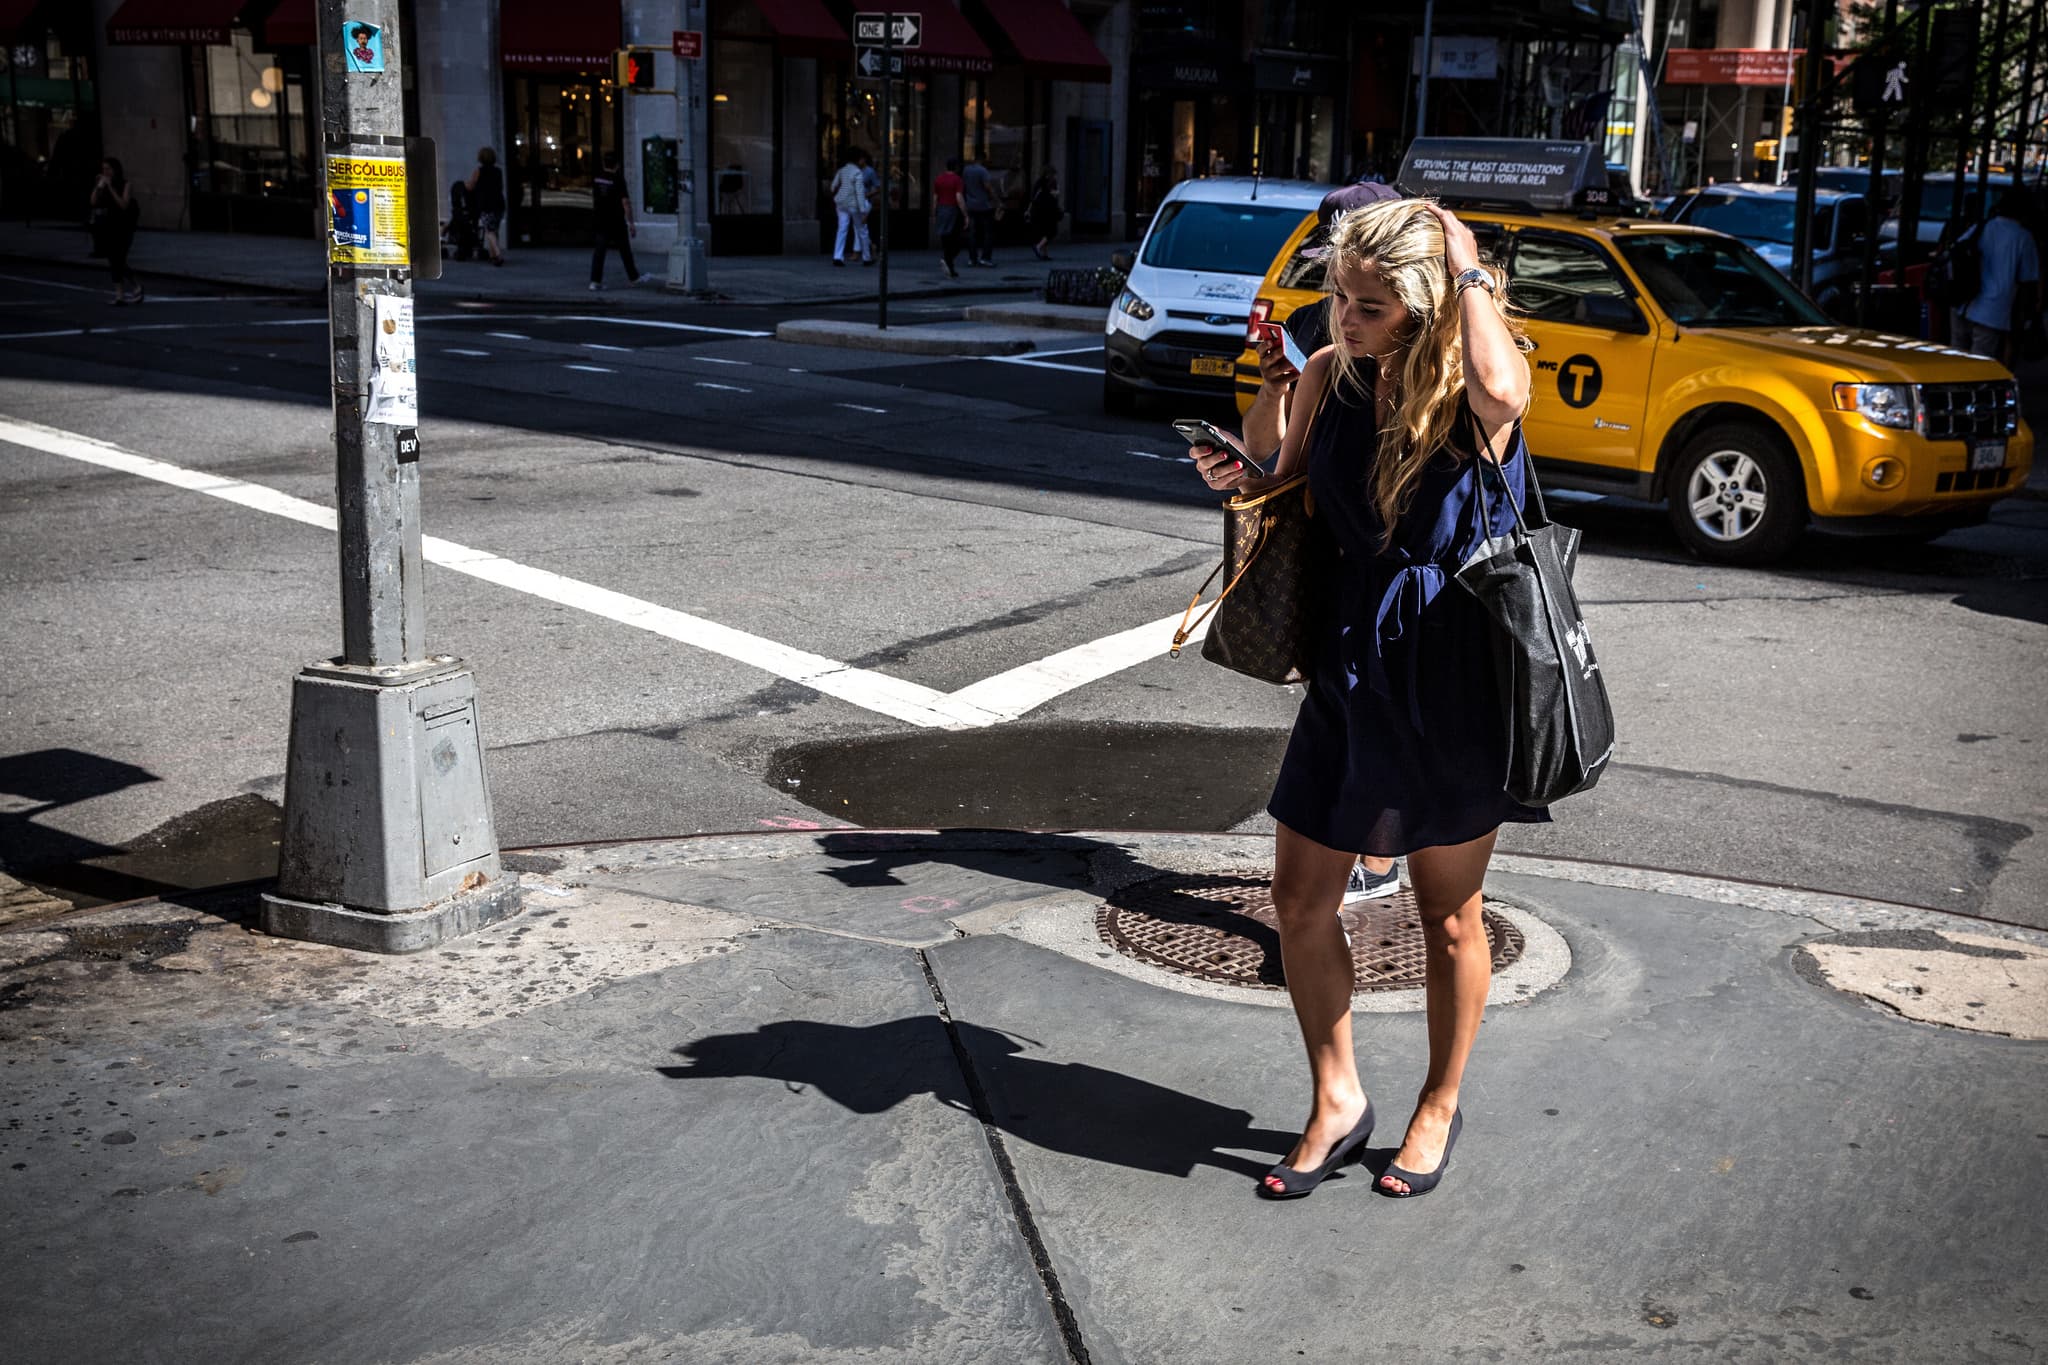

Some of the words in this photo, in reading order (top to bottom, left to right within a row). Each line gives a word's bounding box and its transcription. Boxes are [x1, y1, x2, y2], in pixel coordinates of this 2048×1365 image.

[115, 28, 149, 41] DESIGN
[152, 28, 187, 41] WITHIN
[189, 28, 221, 41] REACH
[861, 24, 880, 36] ONE
[504, 53, 542, 64] DESIGN
[546, 54, 583, 64] WITHIN
[586, 55, 610, 65] REAC
[929, 57, 962, 71] WITHIN
[966, 59, 993, 73] REACH
[1174, 66, 1219, 83] MADURA
[1413, 158, 1452, 172] SERVING
[1453, 160, 1470, 174] THE
[1471, 162, 1498, 175] MOST
[1498, 162, 1565, 176] DESTINATIONS
[1423, 171, 1450, 183] FROM
[1451, 172, 1468, 184] THE
[1469, 173, 1493, 185] NEW
[1494, 174, 1519, 186] YORK
[1519, 175, 1547, 187] AREA
[1537, 360, 1558, 371] NYC
[1568, 364, 1594, 402] T
[401, 439, 417, 453] DEV
